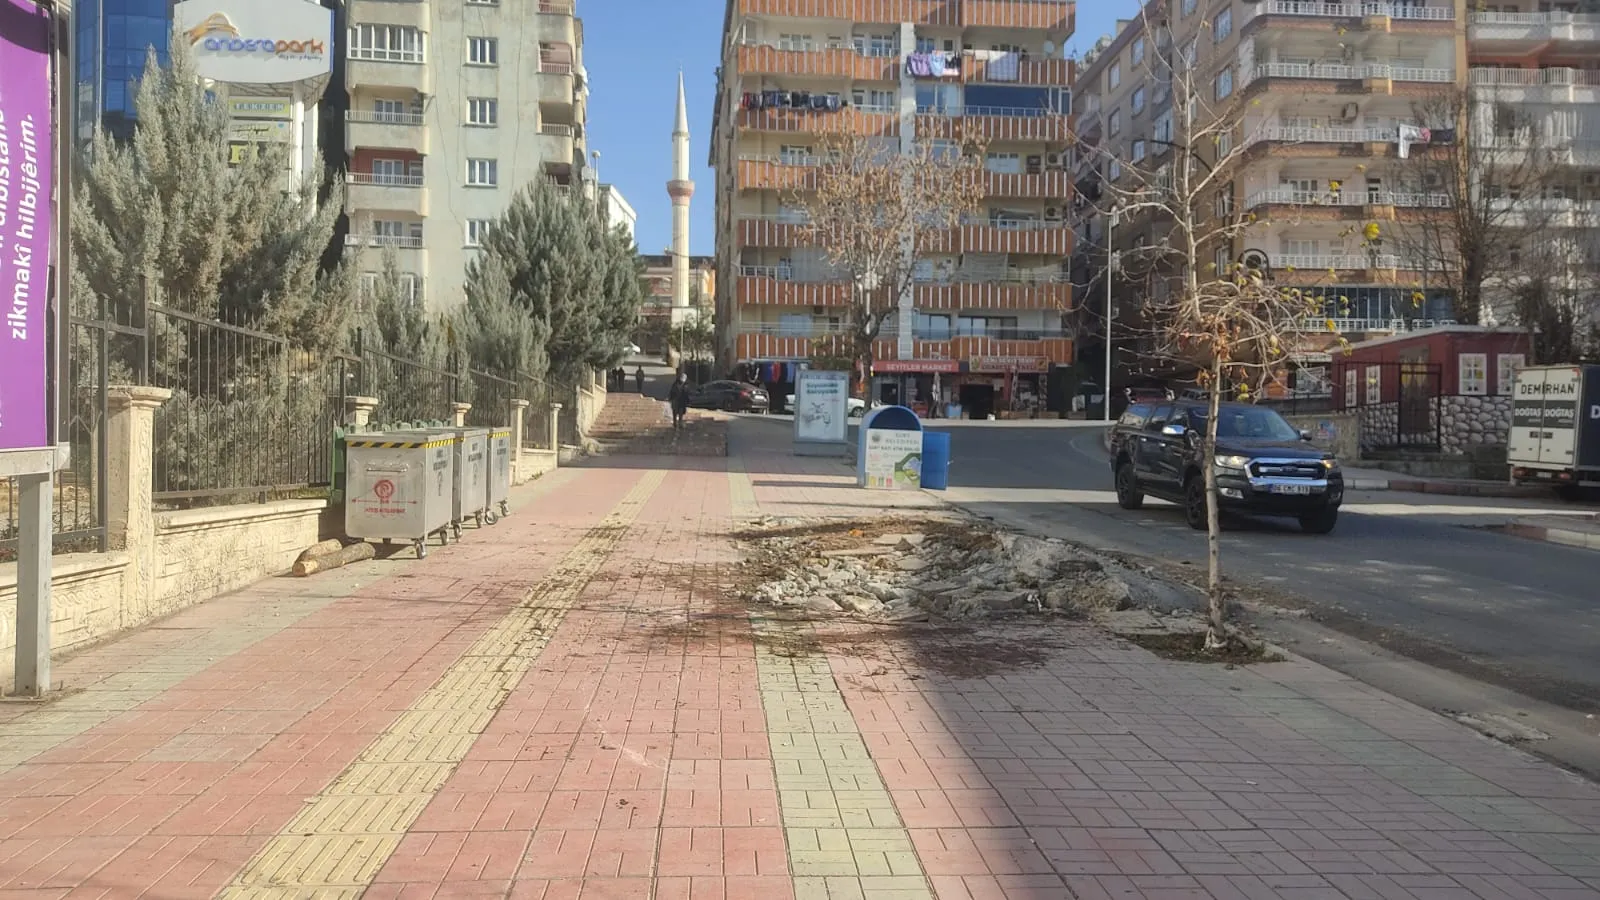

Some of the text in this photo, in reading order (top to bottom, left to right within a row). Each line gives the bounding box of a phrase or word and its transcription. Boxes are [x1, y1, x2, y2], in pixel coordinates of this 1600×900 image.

[7, 113, 41, 340] zikmakî hilbijêrim.
[922, 363, 952, 371] MARKET
